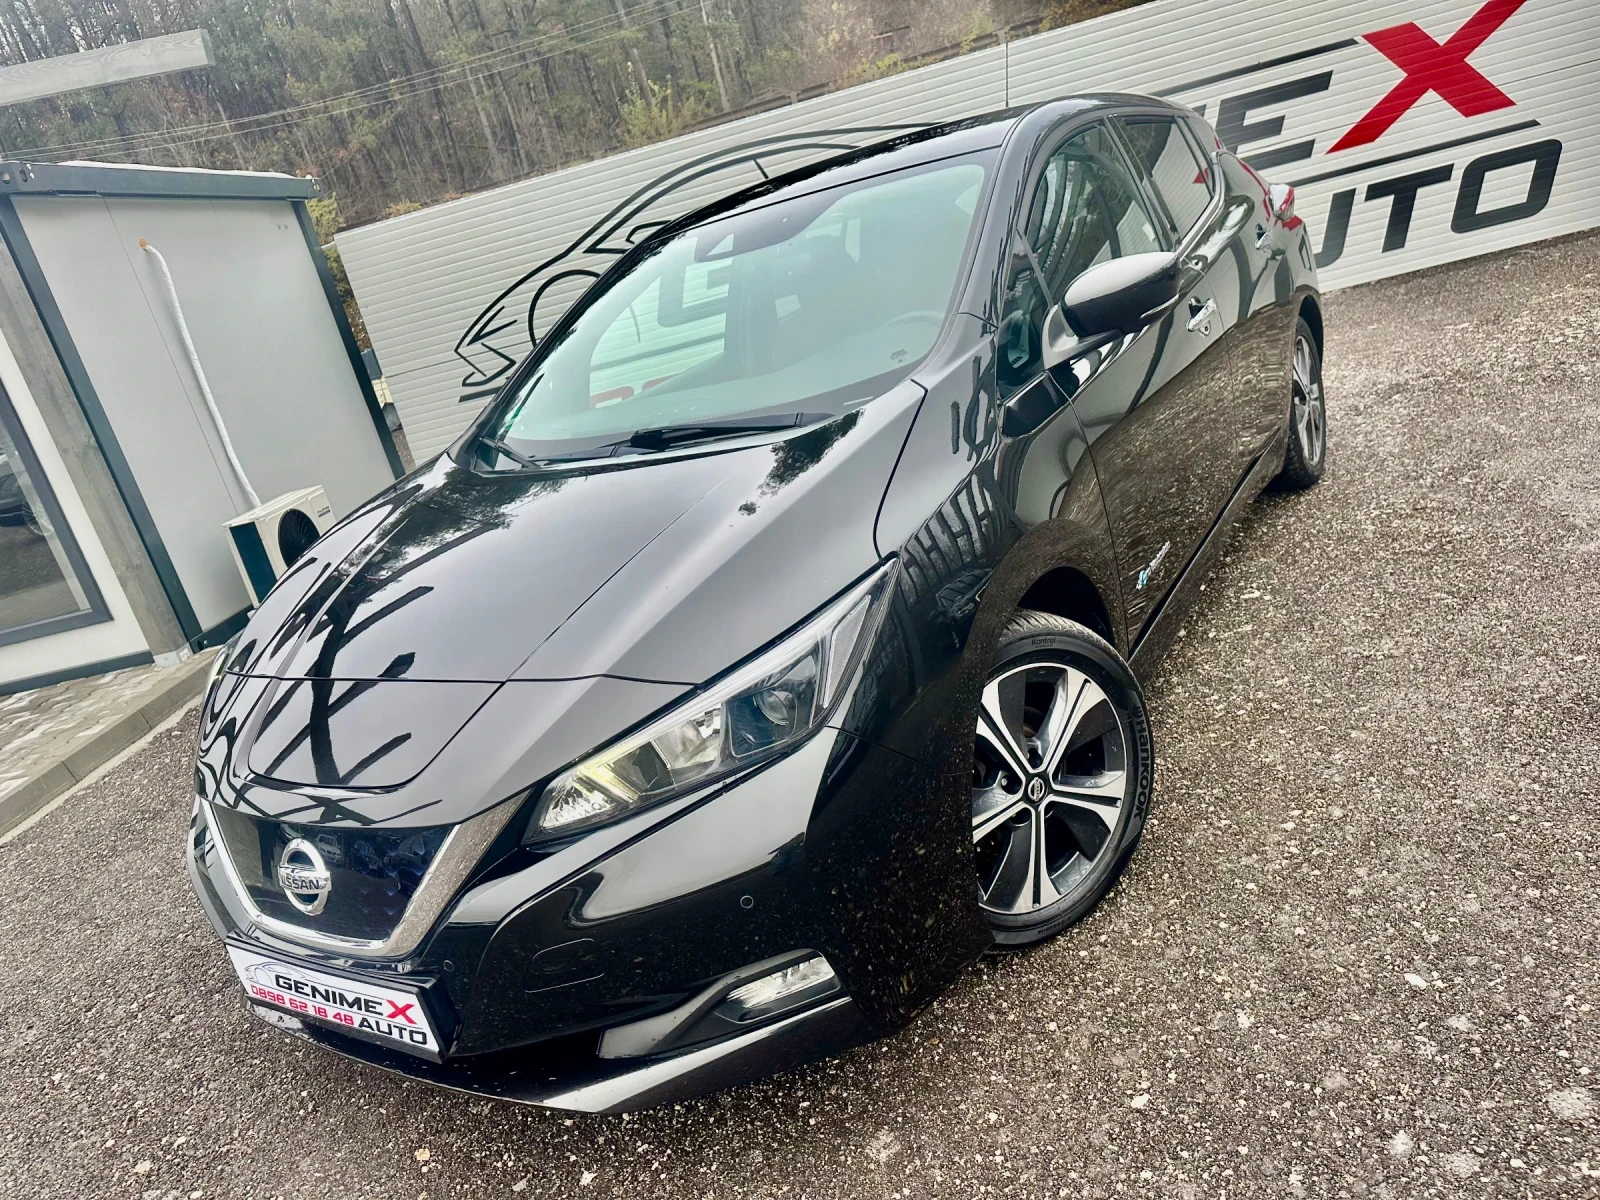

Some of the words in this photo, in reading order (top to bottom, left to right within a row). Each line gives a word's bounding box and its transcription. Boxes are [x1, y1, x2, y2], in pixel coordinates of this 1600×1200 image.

[251, 984, 286, 1005] 0898
[289, 997, 309, 1013] 62
[312, 1004, 328, 1018] 18
[332, 1012, 355, 1026] 48
[274, 974, 418, 1025] GENIMEX
[358, 1017, 428, 1045] AUTO
